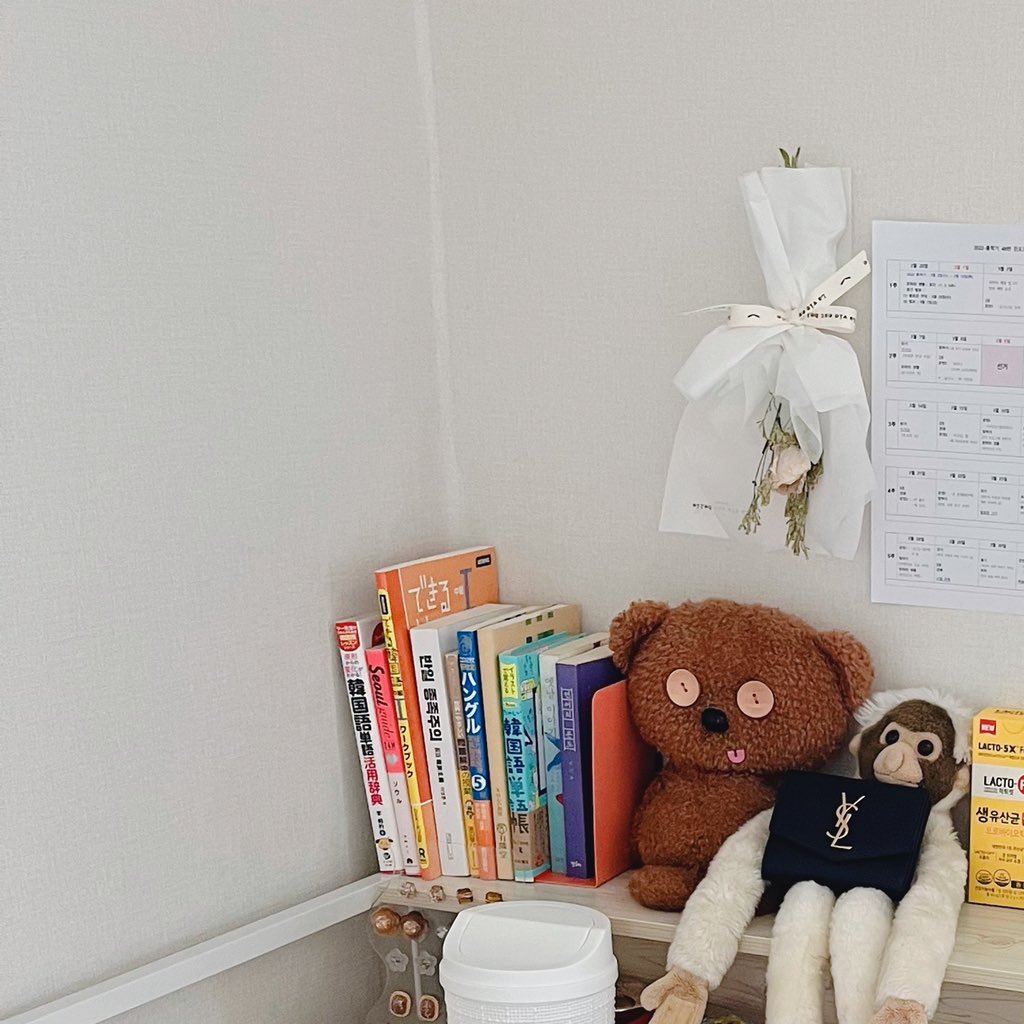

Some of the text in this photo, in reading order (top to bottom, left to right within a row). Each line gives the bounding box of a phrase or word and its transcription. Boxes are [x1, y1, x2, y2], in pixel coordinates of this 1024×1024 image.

[408, 575, 451, 614] できる
[369, 664, 389, 707] Seoul
[461, 671, 481, 734] ハングル
[976, 806, 1021, 825] 생유산균
